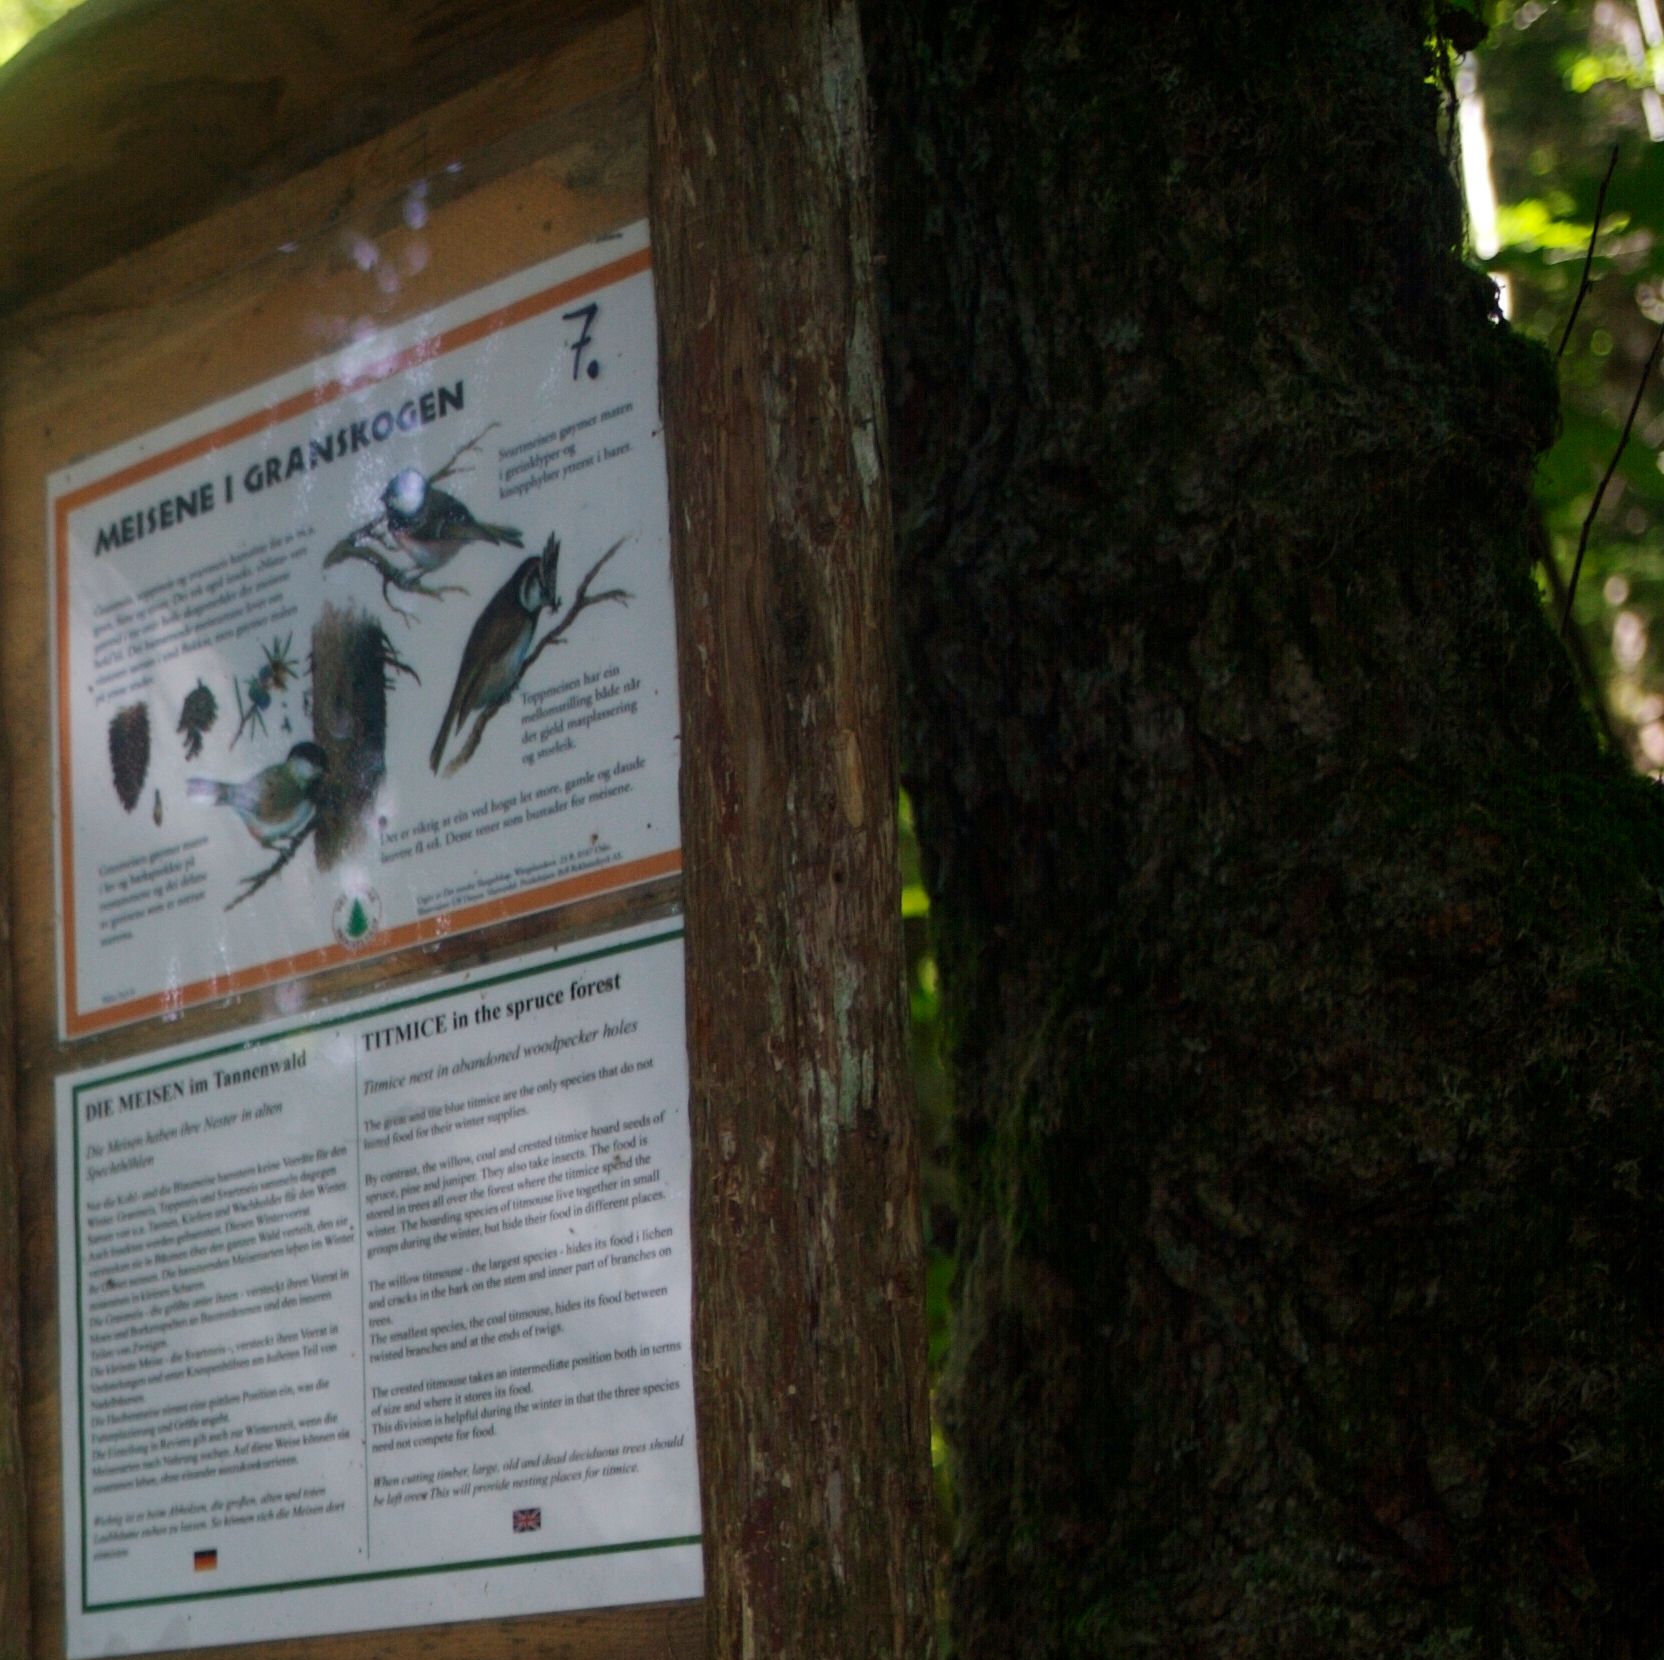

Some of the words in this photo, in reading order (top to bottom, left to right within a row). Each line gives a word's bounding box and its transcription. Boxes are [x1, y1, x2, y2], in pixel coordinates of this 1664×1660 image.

[560, 302, 600, 381] 7.
[93, 490, 216, 557] MEISENE
[222, 474, 237, 509] I
[244, 379, 465, 496] GRANSKOGEN
[361, 1013, 447, 1052] TITMICE
[452, 1010, 468, 1030] in
[474, 1002, 501, 1025] the
[506, 989, 564, 1020] spruce
[569, 972, 621, 1001] forest
[362, 1073, 406, 1095] Titmice
[408, 1066, 434, 1085] nest
[436, 1062, 449, 1078] in
[451, 1043, 521, 1074] abandoned
[523, 1028, 598, 1058] woodpecker
[602, 1019, 638, 1039] holes
[84, 1096, 113, 1121] DIE
[117, 1079, 185, 1113] MEISEN
[188, 1076, 208, 1096] im
[213, 1048, 307, 1090] Tannenwald
[467, 1093, 500, 1109] titmice
[502, 1090, 518, 1101] are
[518, 1084, 535, 1097] the
[536, 1079, 558, 1093] only
[559, 1071, 596, 1090] species
[597, 1065, 618, 1080] that
[619, 1062, 634, 1075] do
[636, 1057, 653, 1071] not
[454, 1115, 485, 1130] winter
[476, 1146, 496, 1161] coal
[498, 1142, 516, 1156] and
[518, 1134, 552, 1152] crested
[554, 1129, 588, 1145] titmice
[590, 1120, 620, 1137] hoard
[622, 1114, 650, 1130] seeds
[652, 1110, 665, 1124] of
[469, 1186, 485, 1199] the
[487, 1181, 514, 1196] forest
[517, 1176, 545, 1190] where
[548, 1170, 562, 1183] the
[565, 1164, 599, 1180] titmice
[601, 1155, 633, 1175] spend
[634, 1152, 651, 1166] the
[481, 1165, 504, 1179] They
[507, 1160, 526, 1173] also
[528, 1155, 549, 1169] take
[590, 1142, 611, 1156] The
[611, 1135, 637, 1152] food
[638, 1134, 648, 1146] is
[464, 1203, 498, 1221] species
[500, 1198, 511, 1211] of
[512, 1193, 553, 1209] titmouse
[556, 1188, 573, 1200] live
[575, 1179, 618, 1198] together
[619, 1176, 630, 1188] in
[633, 1168, 660, 1185] small
[484, 1221, 499, 1233] but
[501, 1216, 522, 1230] hide
[524, 1211, 546, 1225] their
[549, 1205, 571, 1221] food
[573, 1204, 582, 1216] in
[584, 1196, 628, 1214] different
[471, 1260, 487, 1273] the
[488, 1254, 521, 1270] largest
[521, 1247, 557, 1266] species
[566, 1241, 592, 1255] hides
[594, 1238, 607, 1250] its
[609, 1231, 634, 1247] food
[642, 1226, 673, 1241] lichen
[471, 1281, 484, 1291] on
[503, 1273, 526, 1285] stem
[527, 1267, 546, 1281] and
[547, 1265, 573, 1278] inner
[575, 1259, 595, 1276] part
[597, 1255, 608, 1269] of
[610, 1249, 656, 1266] branches
[658, 1247, 671, 1258] on
[554, 1300, 581, 1314] hides
[583, 1297, 596, 1309] its
[597, 1291, 622, 1306] food
[623, 1286, 667, 1302] between
[521, 1325, 533, 1338] of
[509, 1359, 569, 1377] intermediate
[571, 1351, 611, 1370] position
[613, 1345, 637, 1361] both
[639, 1344, 650, 1356] in
[652, 1342, 680, 1354] terms
[480, 1404, 512, 1418] during
[513, 1401, 529, 1414] the
[531, 1398, 562, 1411] winter
[564, 1394, 574, 1406] in
[576, 1392, 594, 1404] that
[596, 1388, 612, 1401] the
[614, 1386, 640, 1399] three
[641, 1379, 679, 1397] species
